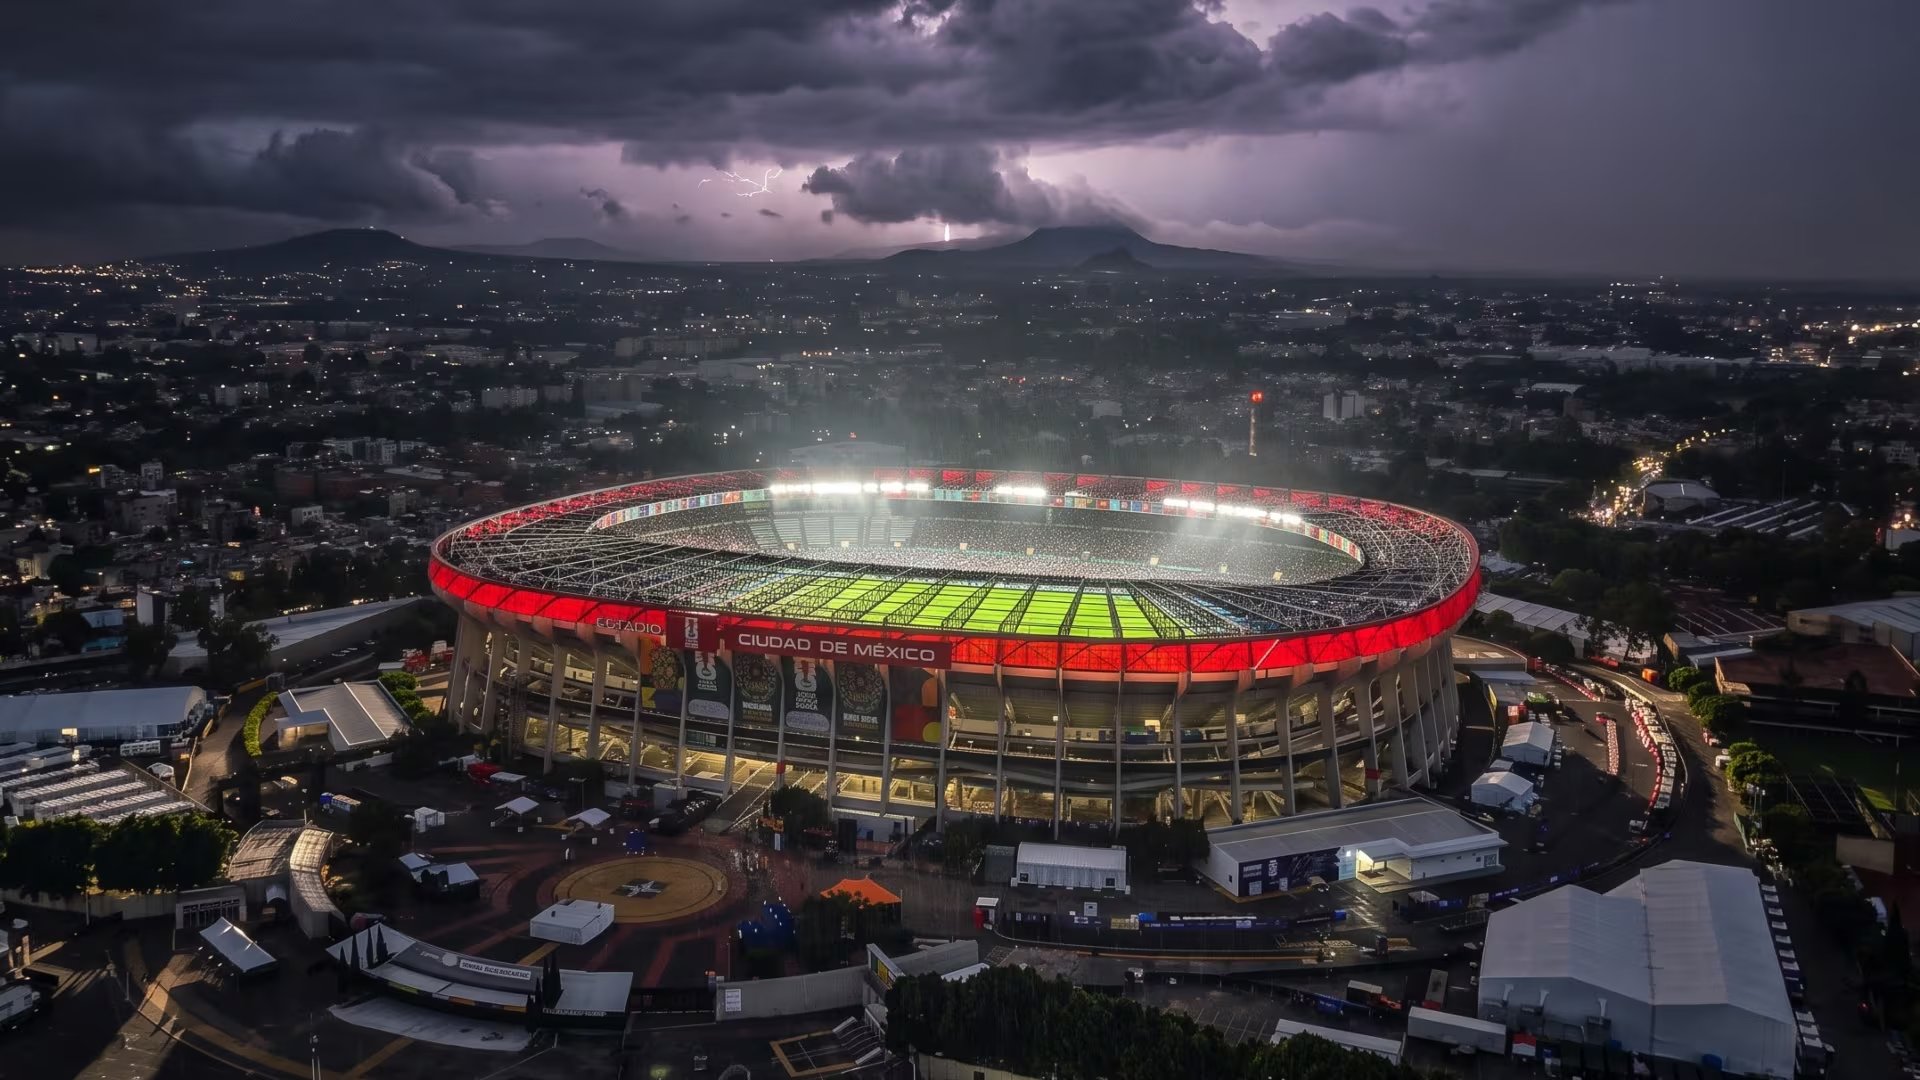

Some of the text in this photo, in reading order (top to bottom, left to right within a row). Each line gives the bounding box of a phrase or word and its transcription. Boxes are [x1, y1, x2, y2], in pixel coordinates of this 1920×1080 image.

[738, 633, 935, 662] CIUDAD DE MÉXICO
